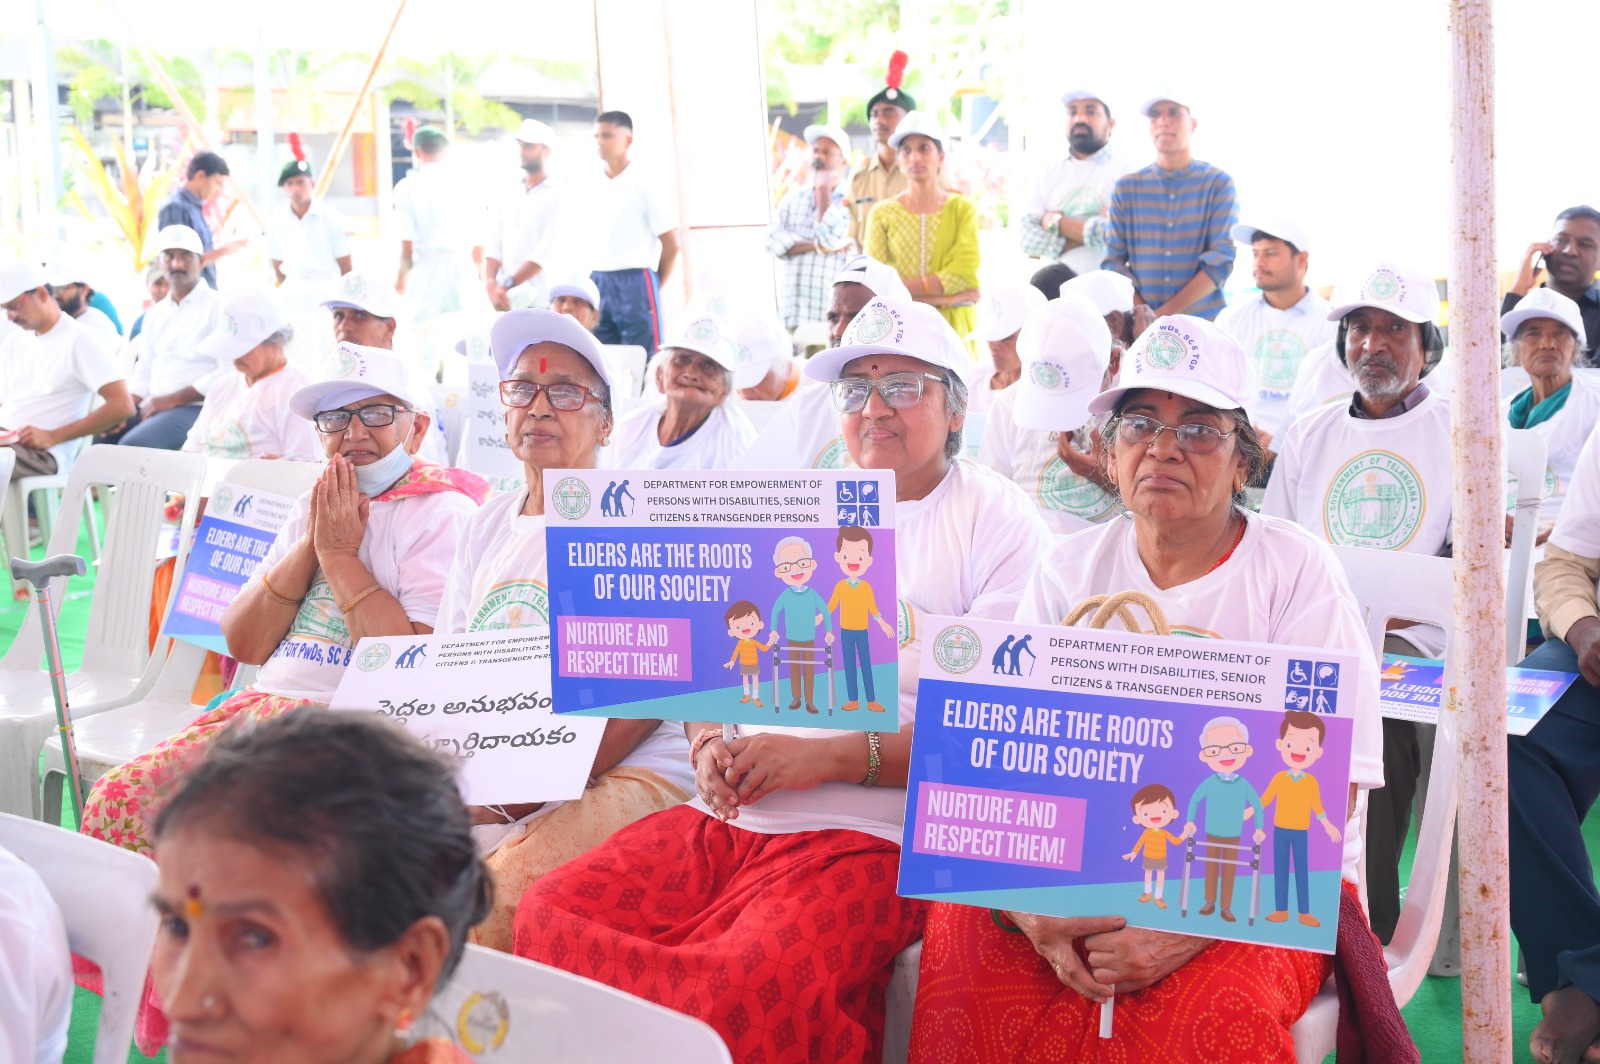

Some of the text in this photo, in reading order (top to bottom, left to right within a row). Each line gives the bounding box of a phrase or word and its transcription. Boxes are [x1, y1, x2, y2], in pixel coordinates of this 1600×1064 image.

[890, 309, 901, 319] SC
[894, 328, 904, 344] TGP
[1159, 324, 1181, 336] wDs,
[1183, 334, 1195, 345] SC
[1188, 354, 1200, 371] TGP
[644, 480, 822, 489] DEPARTMENT FOR EMPOWERMENT OF
[1330, 461, 1364, 511] GOVERNMENT
[1386, 460, 1418, 502] TELANGANA
[259, 498, 289, 510] DEPARTMENT
[647, 497, 820, 507] PERSONS WITH DISABILITIES, SENIOR
[650, 514, 819, 522] CITIZENS & TRANSGENDER PERSONS
[205, 527, 237, 550] ELDERS
[234, 535, 253, 554] ARE
[252, 539, 268, 558] THE
[210, 550, 225, 568] OF
[222, 553, 244, 574] OUR
[568, 542, 752, 569] ELDERS ARE THE ROOTS
[187, 577, 238, 603] NURTURE AND
[594, 573, 731, 602] OF OUR SOCIETY
[180, 595, 211, 619] RESPECT
[469, 592, 512, 632] VERNMENT
[508, 635, 550, 644] EMPOWERM
[566, 622, 668, 647] NURTURE AND
[298, 643, 324, 666] PwDs,
[327, 646, 342, 665] SC
[343, 650, 352, 666] &
[479, 655, 532, 664] TRANSGENDER
[494, 646, 542, 654] DISABILITIES,
[1050, 638, 1271, 666] DEPARTMENT FOR EMPOWERMENT OF
[568, 650, 678, 677] RESPECT THEM!
[1051, 657, 1266, 684] PERSONS WITH DISABILITIES, SENIOR
[1051, 676, 1262, 703] CITIZENS & TRANSGENDER PERSONS
[1380, 690, 1437, 703] THE ROO
[1387, 683, 1441, 695] OCIETY
[943, 699, 1174, 749] ELDERS ARE THE ROOTS
[970, 737, 1144, 784] OF OUR SOCIETY
[927, 790, 1058, 829] NURTURE AND
[923, 822, 1066, 864] RESPECT THEM!
